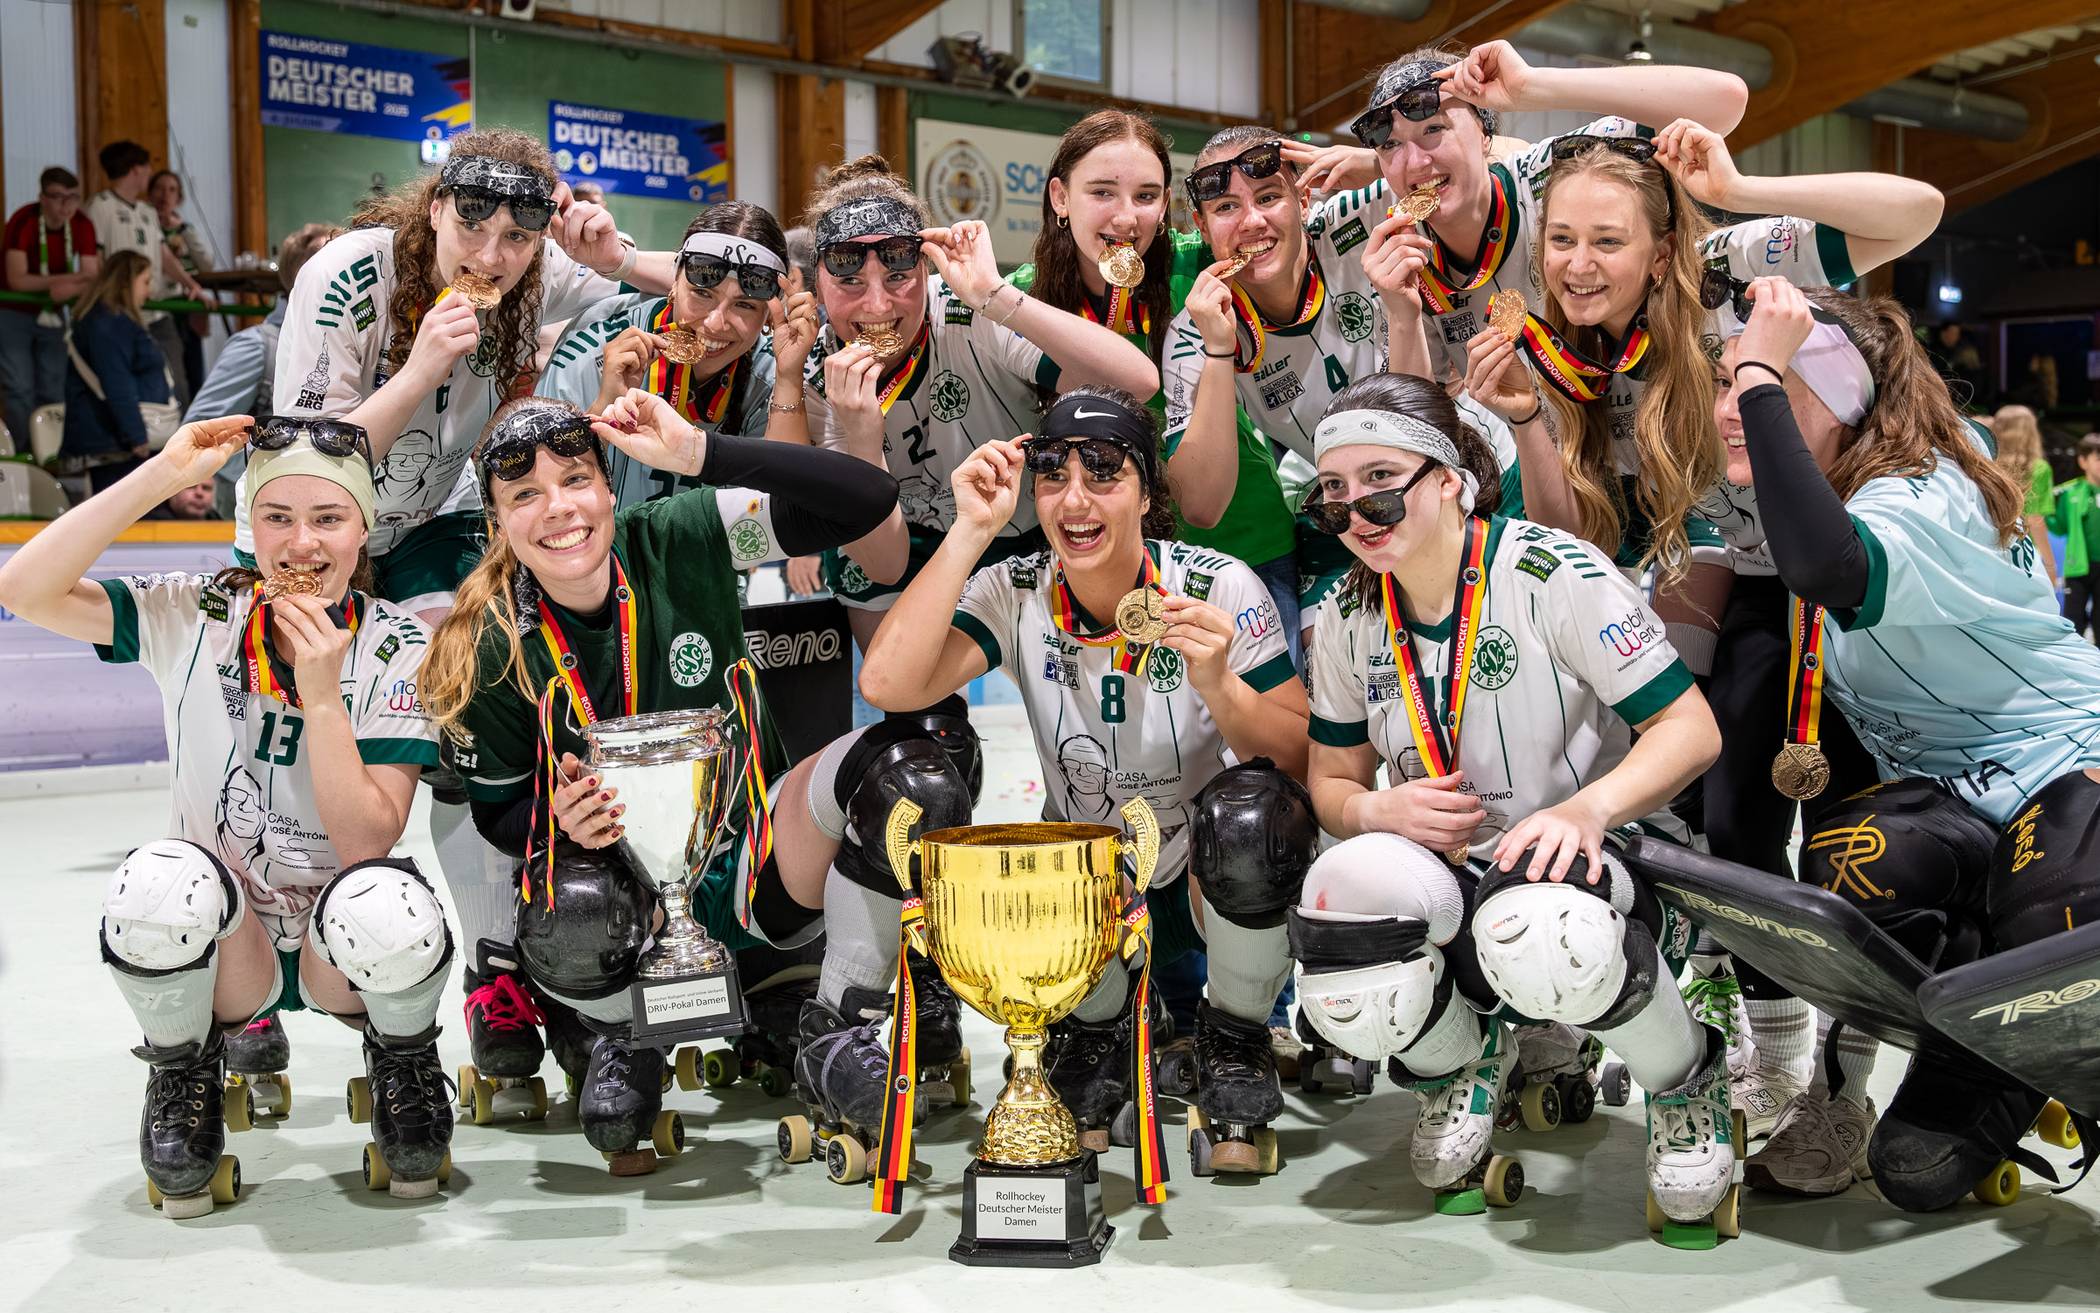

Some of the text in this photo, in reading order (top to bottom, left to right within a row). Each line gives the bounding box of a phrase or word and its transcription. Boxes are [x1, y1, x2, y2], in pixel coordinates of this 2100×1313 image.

[267, 34, 348, 57] ROLLHOCKEY
[267, 55, 414, 96] DEUTSCHER
[268, 79, 376, 112] MEISTER
[555, 120, 679, 153] DEUTSCHER
[600, 147, 690, 176] MEISTER
[1324, 354, 1349, 394] 4
[1536, 349, 1576, 393] ROLLHOCKEY
[295, 399, 323, 411] BRG
[300, 389, 327, 401] CRN
[1278, 385, 1303, 403] LIGA
[622, 631, 631, 693] ROLLHOCKEY
[669, 632, 712, 687] CRONENBERG
[678, 643, 702, 674] RSC
[744, 628, 838, 670] Reno
[1152, 647, 1177, 679] RSC
[1454, 615, 1470, 680] ROLLHOCKEY
[1480, 641, 1504, 676] RSC
[1101, 675, 1126, 723] 8
[1407, 673, 1432, 733] ROLLHOCKEY
[255, 710, 304, 767] 13
[1115, 771, 1148, 783] CASA
[1115, 775, 1182, 790] JOSÉ ANTÓNIO
[267, 812, 301, 829] CASA
[647, 996, 727, 1013] DRIV-Pokal Damen
[900, 977, 911, 1044] ROLLHOCKEY
[1144, 1052, 1155, 1119] ROLLHOCKEY
[978, 1203, 1064, 1215] Deutscher Meister
[996, 1191, 1046, 1203] Rollhockey
[1004, 1216, 1037, 1227] Damen
